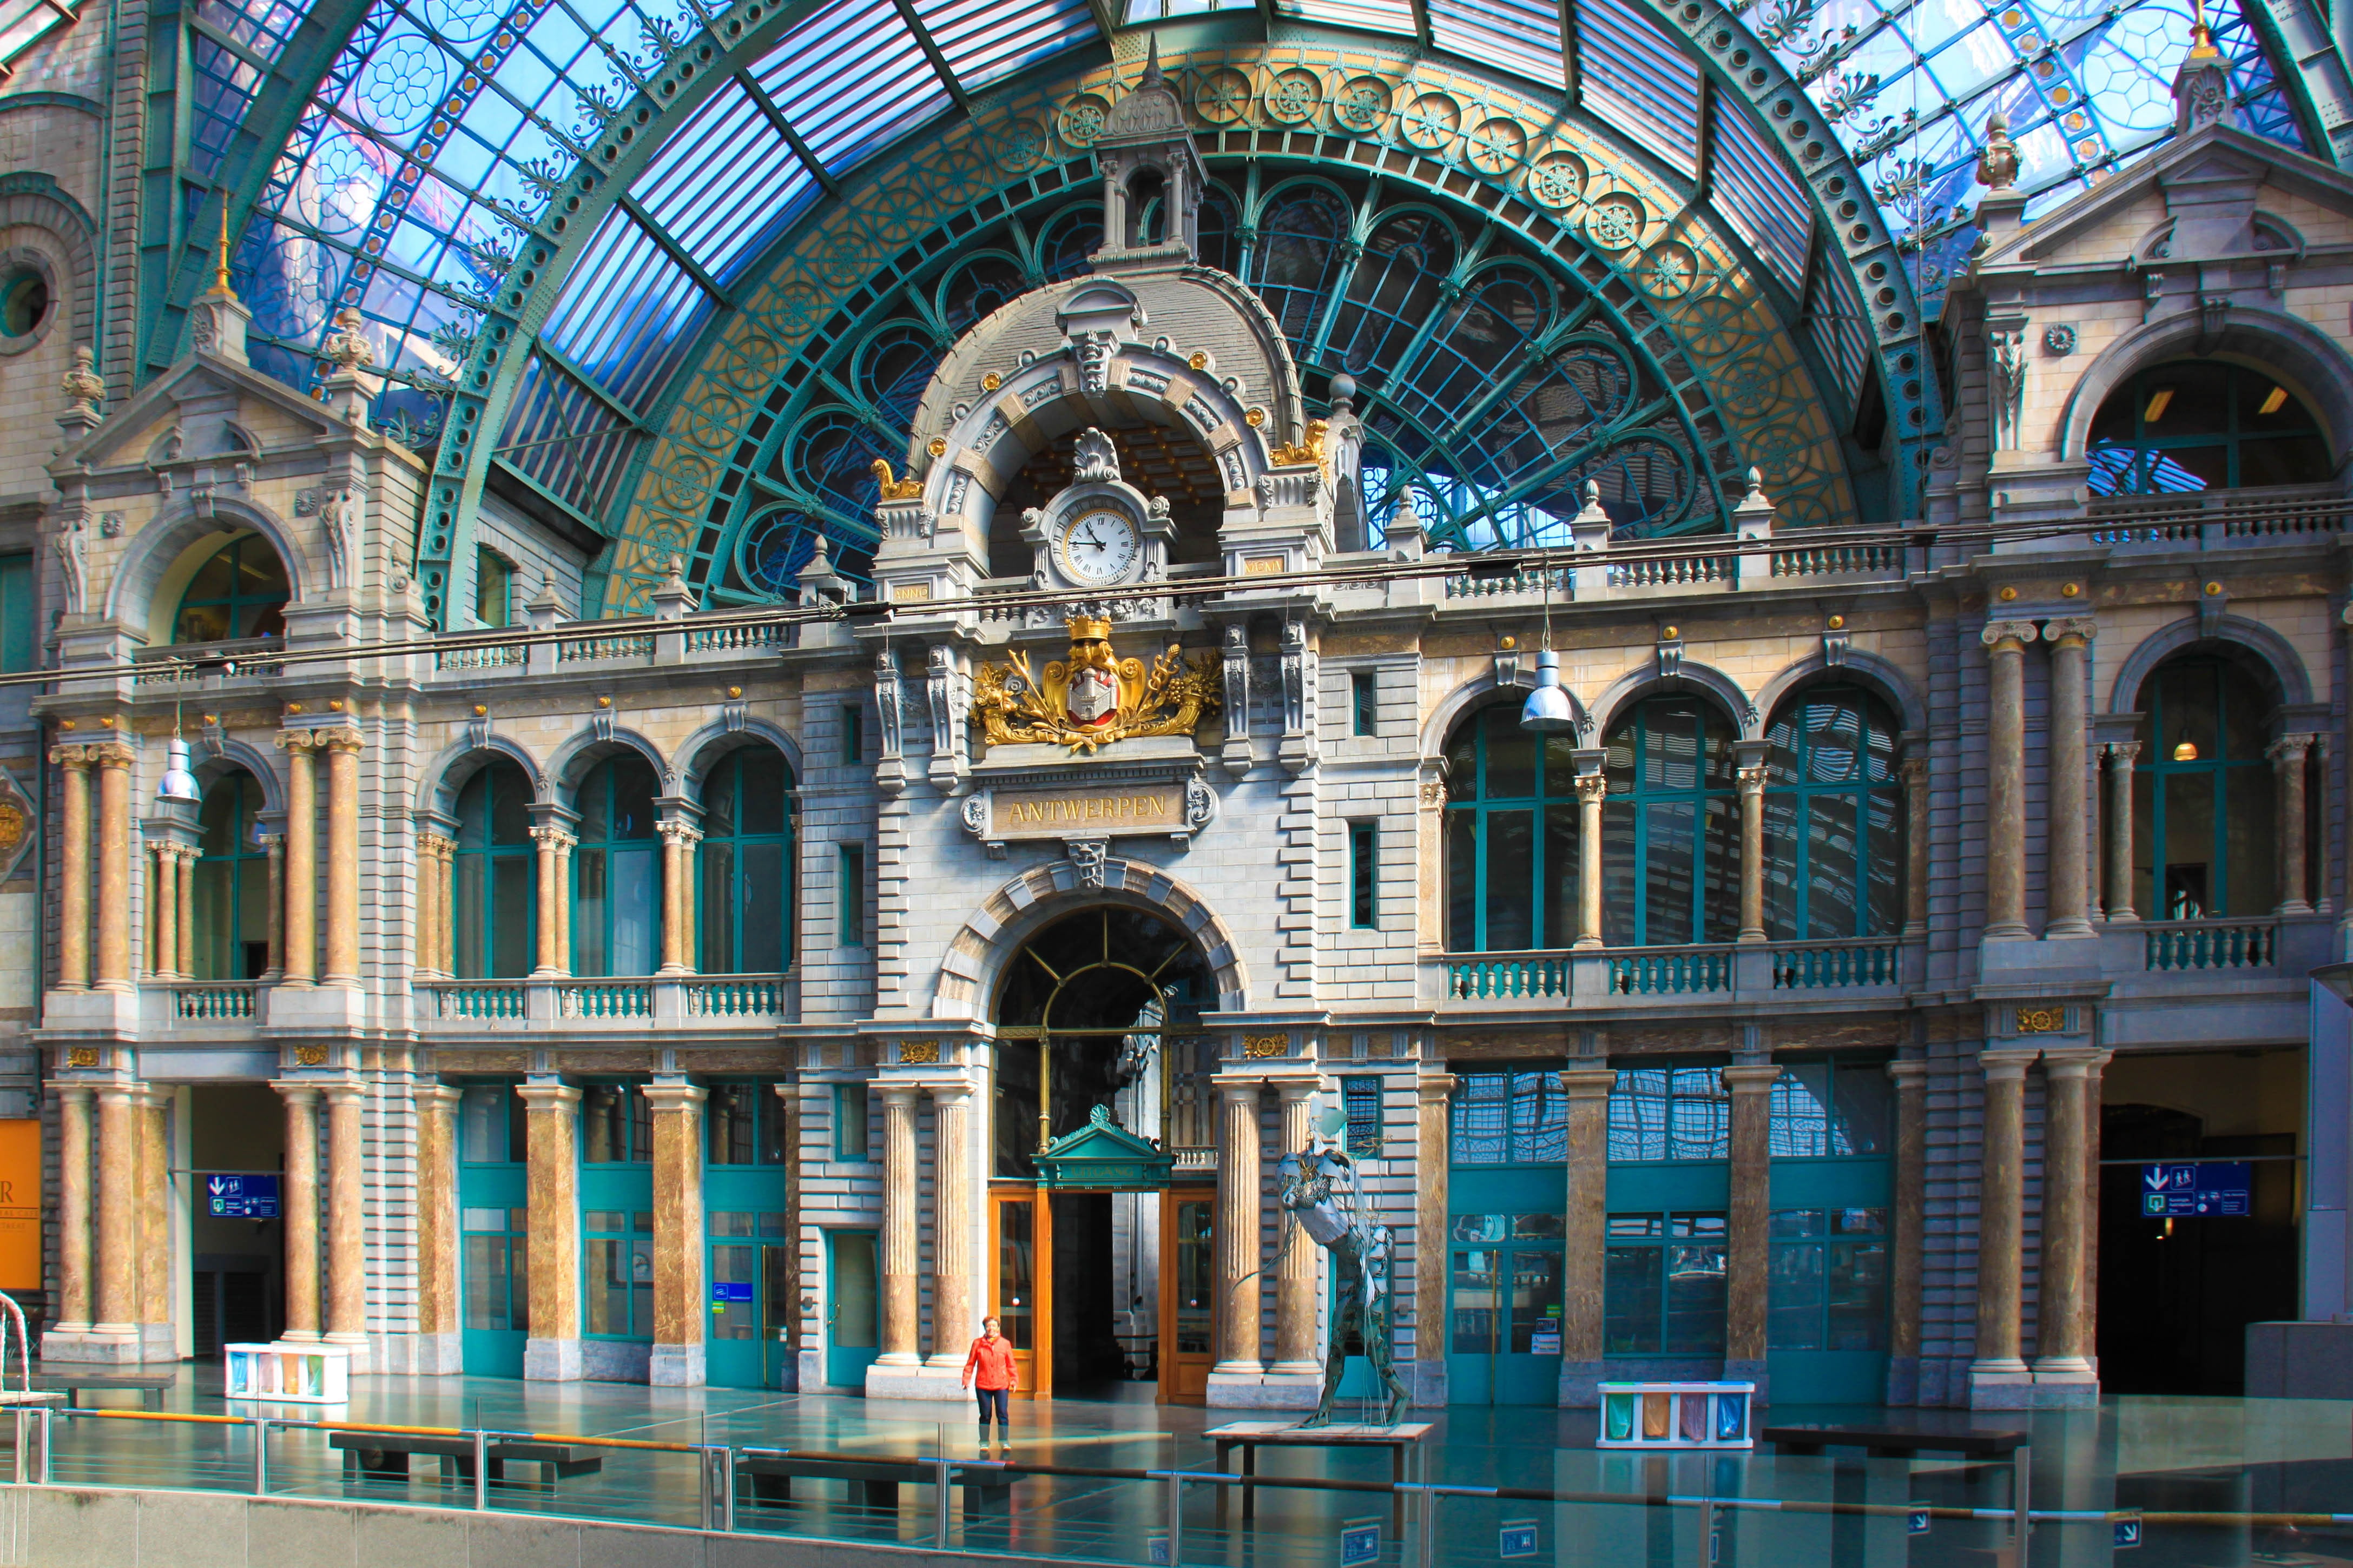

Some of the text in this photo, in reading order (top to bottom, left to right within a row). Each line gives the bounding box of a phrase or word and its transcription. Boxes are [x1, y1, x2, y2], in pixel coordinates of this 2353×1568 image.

[895, 587, 928, 600] ANNO
[1008, 796, 1165, 823] ANTWERPEN
[1071, 1166, 1134, 1177] UITGANG
